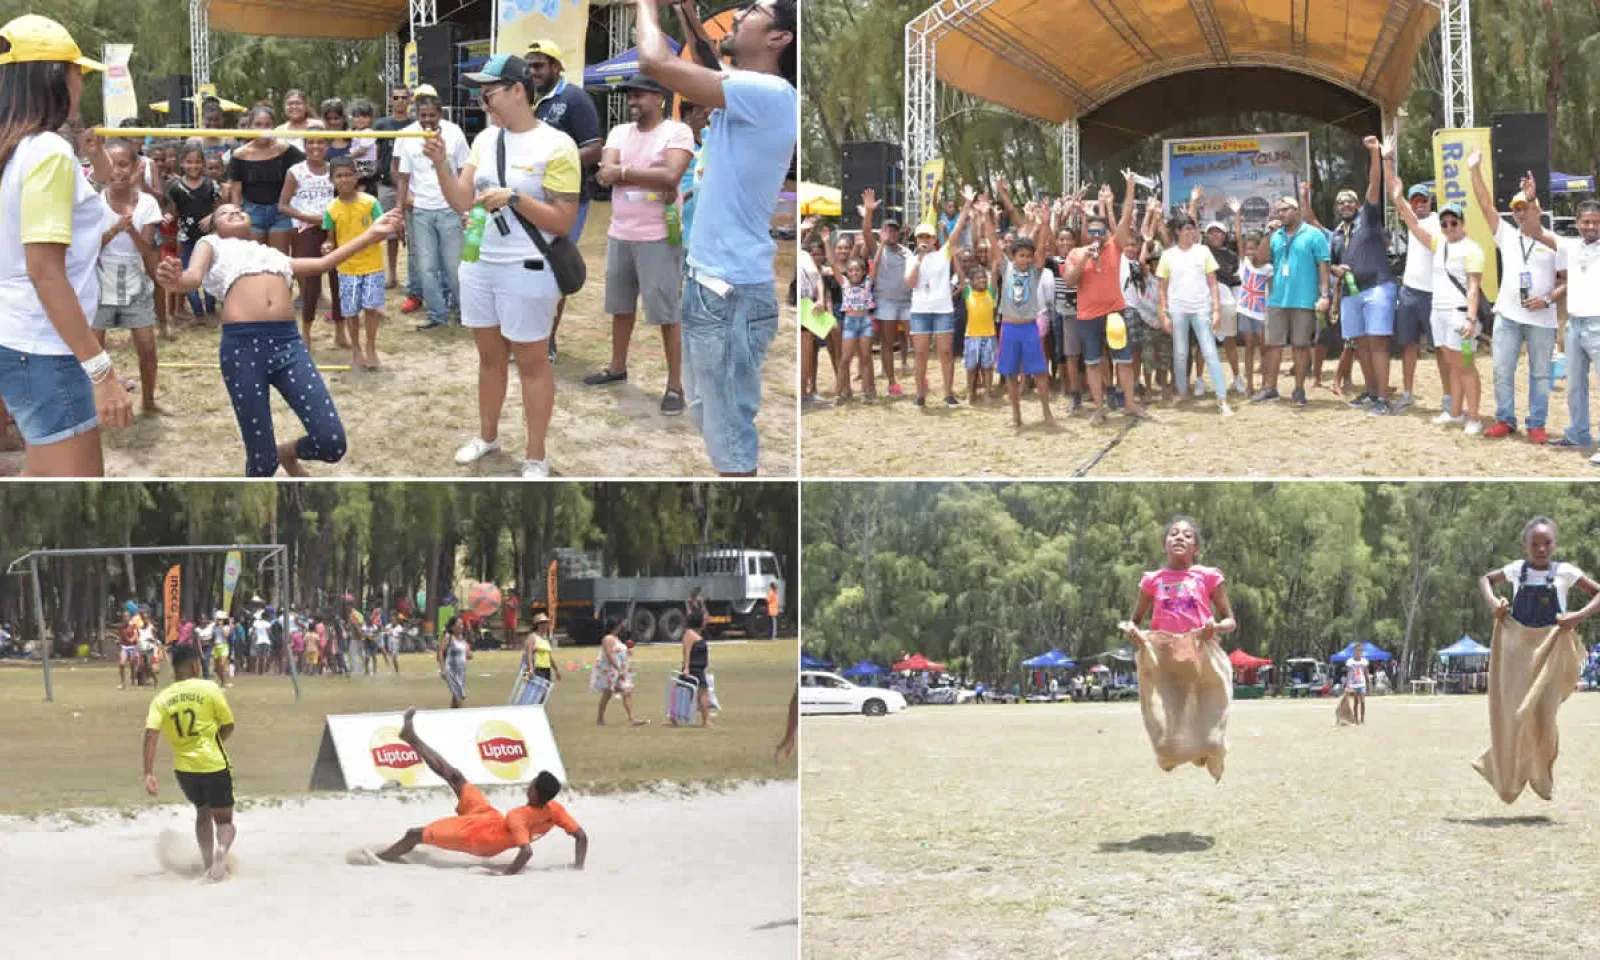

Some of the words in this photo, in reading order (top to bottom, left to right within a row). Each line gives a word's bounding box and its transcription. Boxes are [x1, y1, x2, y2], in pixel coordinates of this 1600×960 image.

[1441, 143, 1467, 207] Rad
[170, 708, 199, 737] 12
[376, 749, 419, 765] Lipton
[482, 743, 523, 758] Lipton
